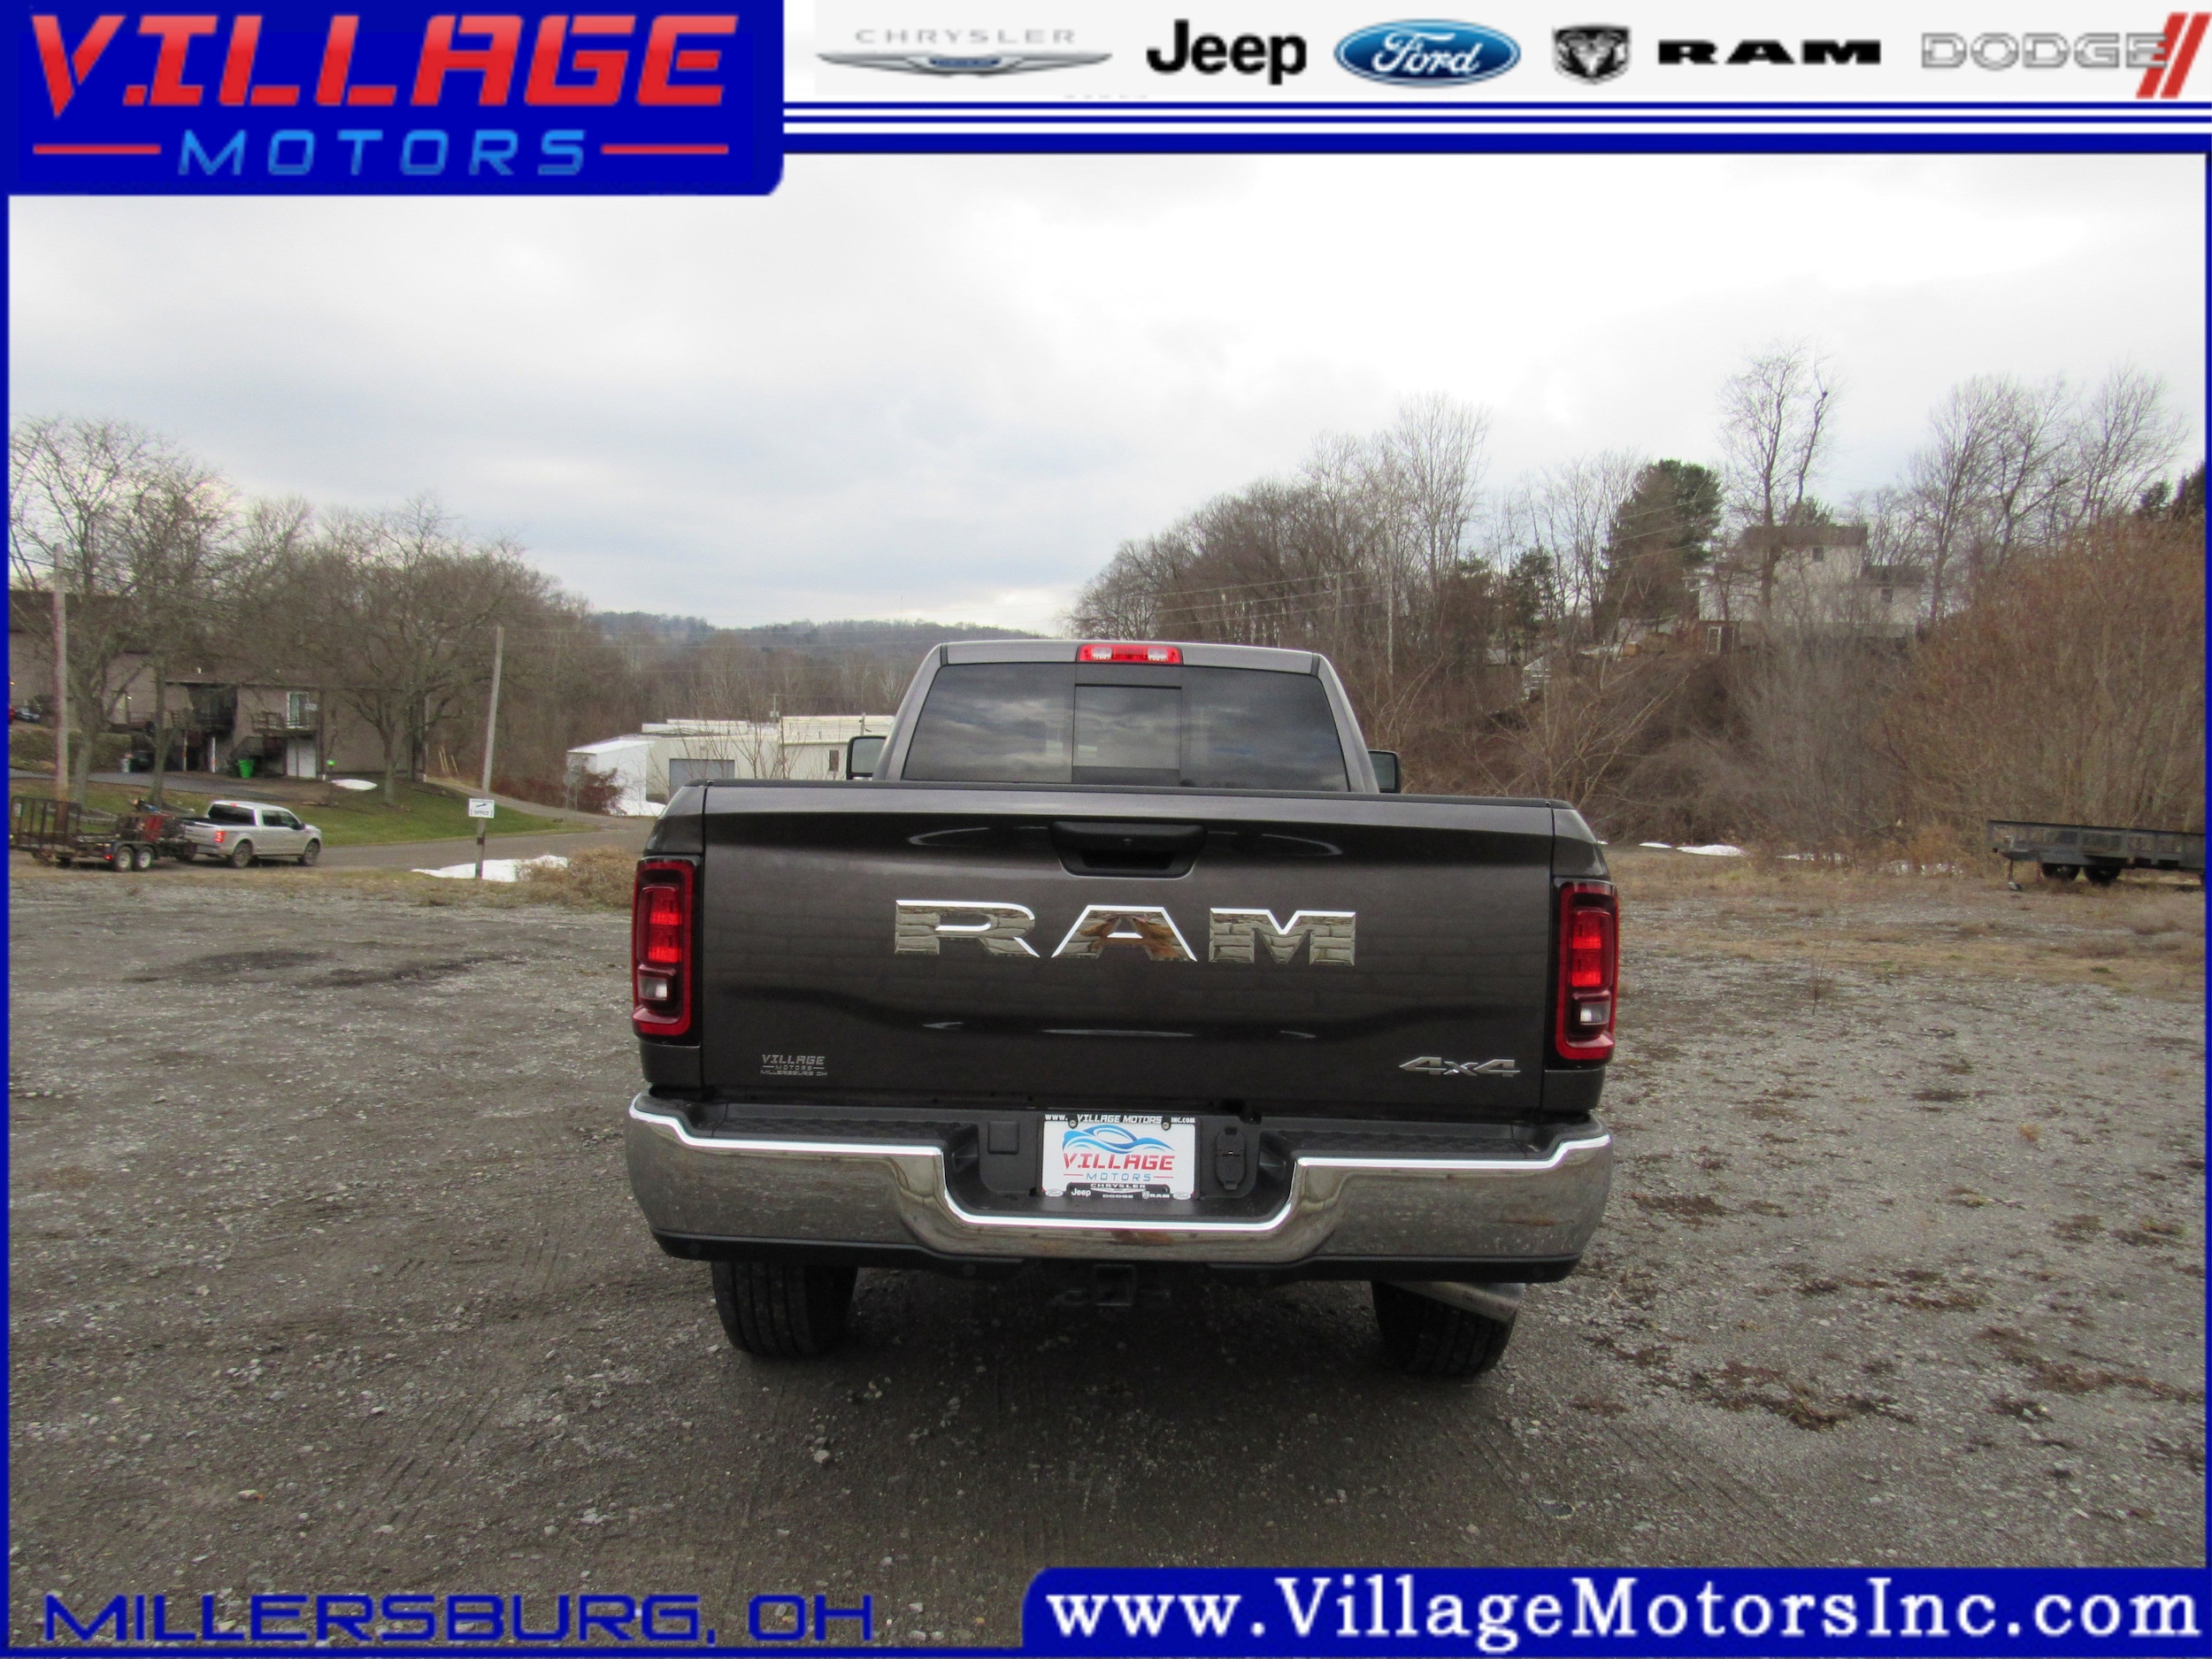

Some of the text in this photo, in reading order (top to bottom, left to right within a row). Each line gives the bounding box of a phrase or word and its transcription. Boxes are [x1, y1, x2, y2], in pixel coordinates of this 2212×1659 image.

[895, 900, 1356, 966] RAM
[1077, 1114, 1120, 1123] VILLAGE
[1123, 1115, 1163, 1124] MOTORS
[1086, 1172, 1151, 1182] MOTORS
[1071, 1187, 1092, 1197] Jeep
